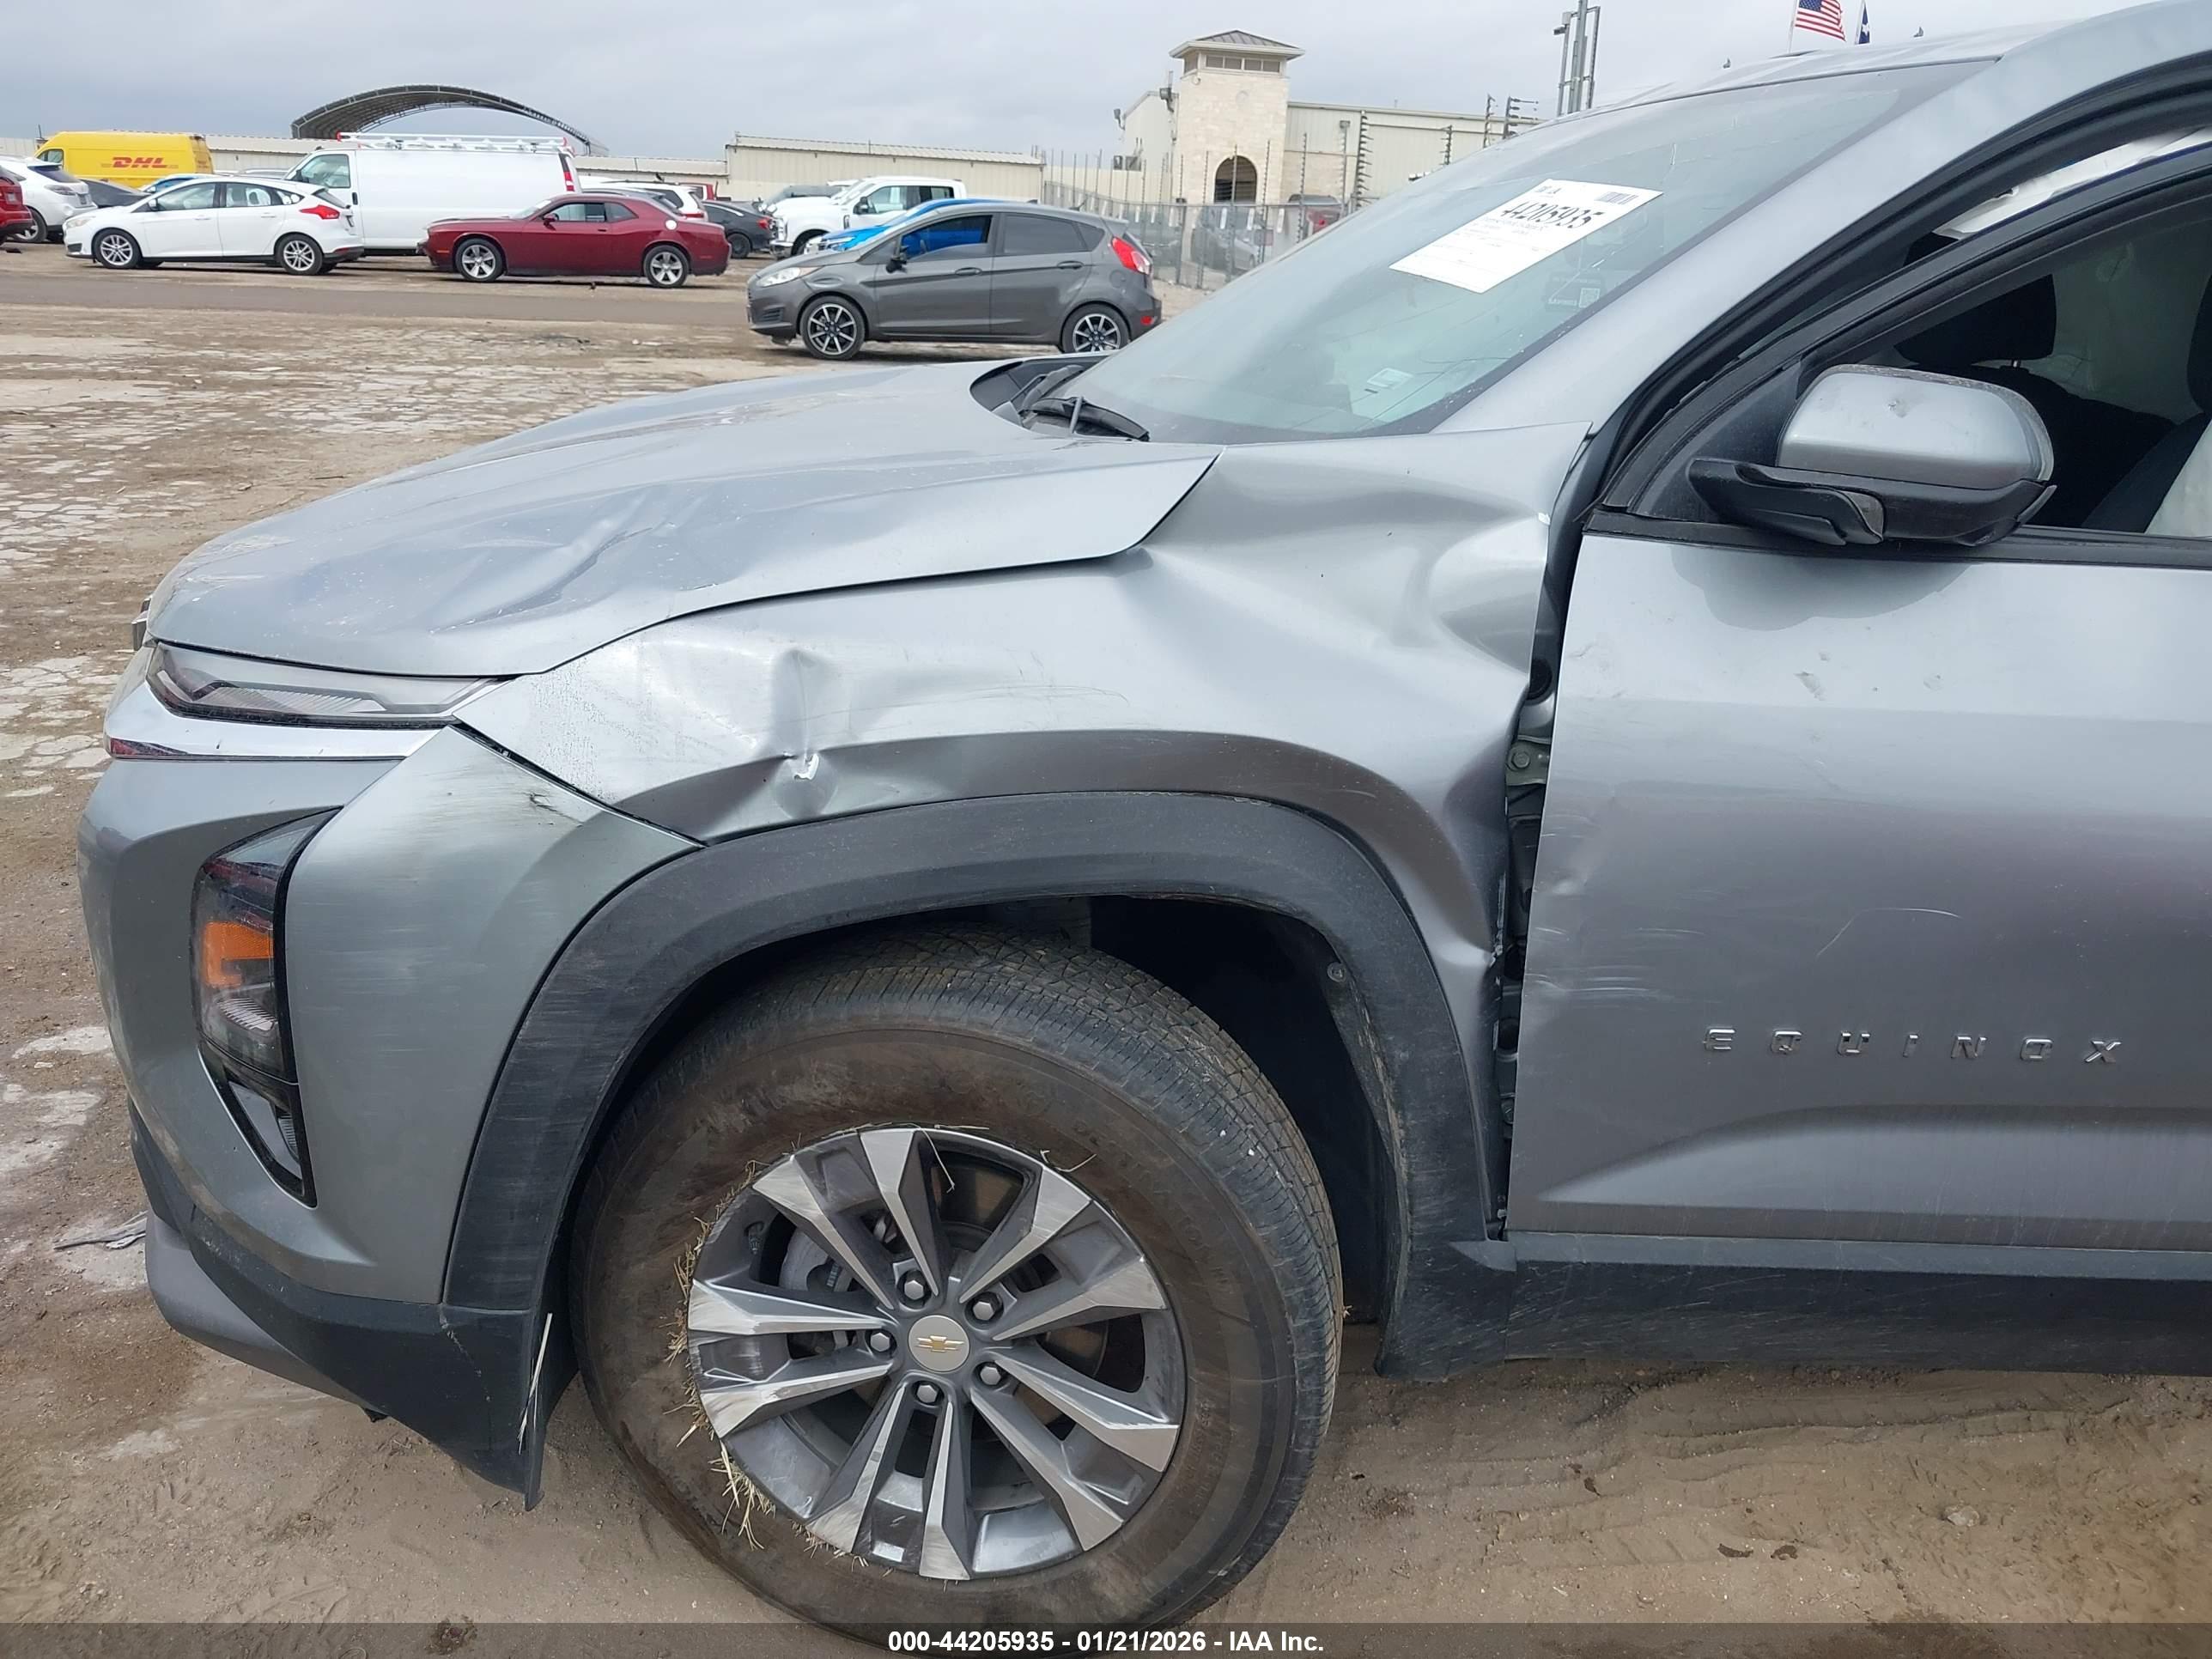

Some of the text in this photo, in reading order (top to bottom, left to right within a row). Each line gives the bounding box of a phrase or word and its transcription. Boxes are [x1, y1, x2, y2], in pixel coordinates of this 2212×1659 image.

[112, 156, 167, 168] DHL
[1500, 201, 1605, 228] 44205935
[1704, 1027, 2122, 1064] EQUINOX
